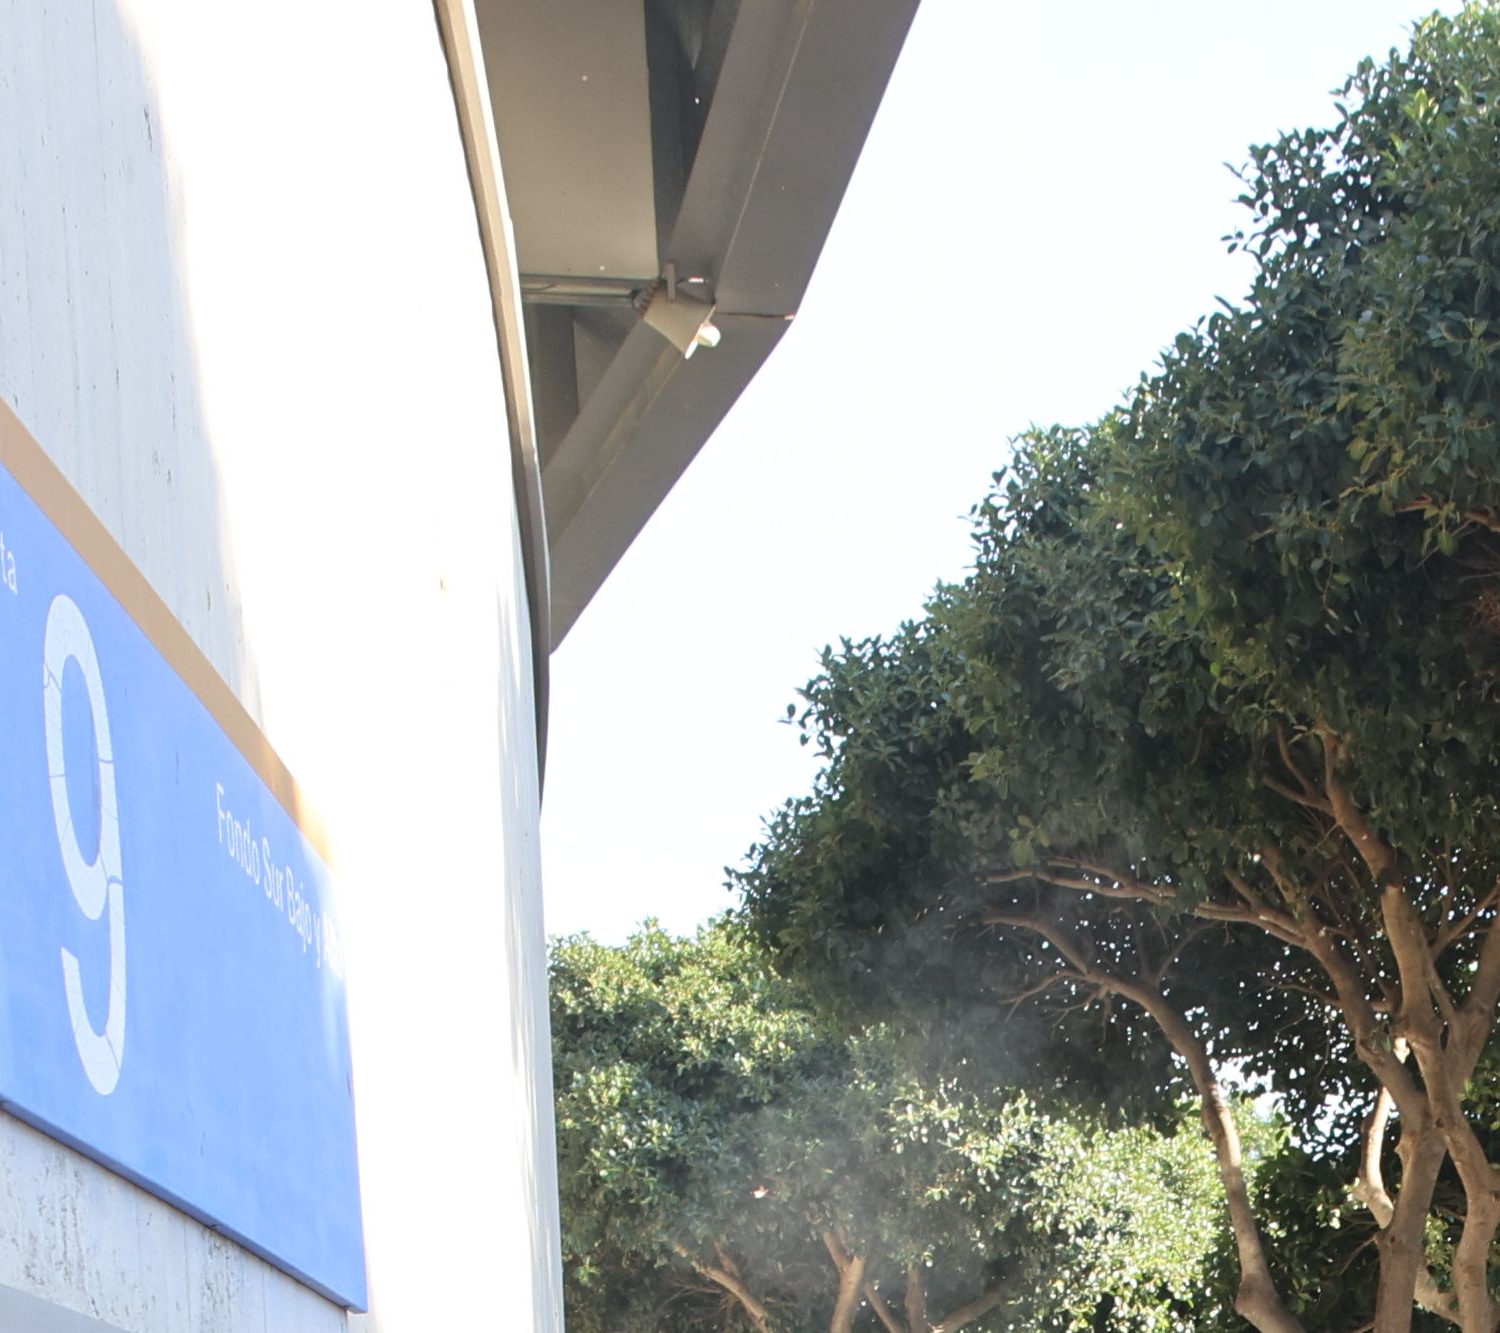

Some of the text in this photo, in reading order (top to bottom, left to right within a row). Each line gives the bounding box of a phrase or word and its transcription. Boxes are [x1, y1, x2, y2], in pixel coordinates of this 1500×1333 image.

[42, 595, 127, 1096] 9
[216, 782, 260, 885] Fondo
[262, 837, 284, 912] Sur
[286, 865, 312, 952] Bajo
[313, 913, 321, 969] y
